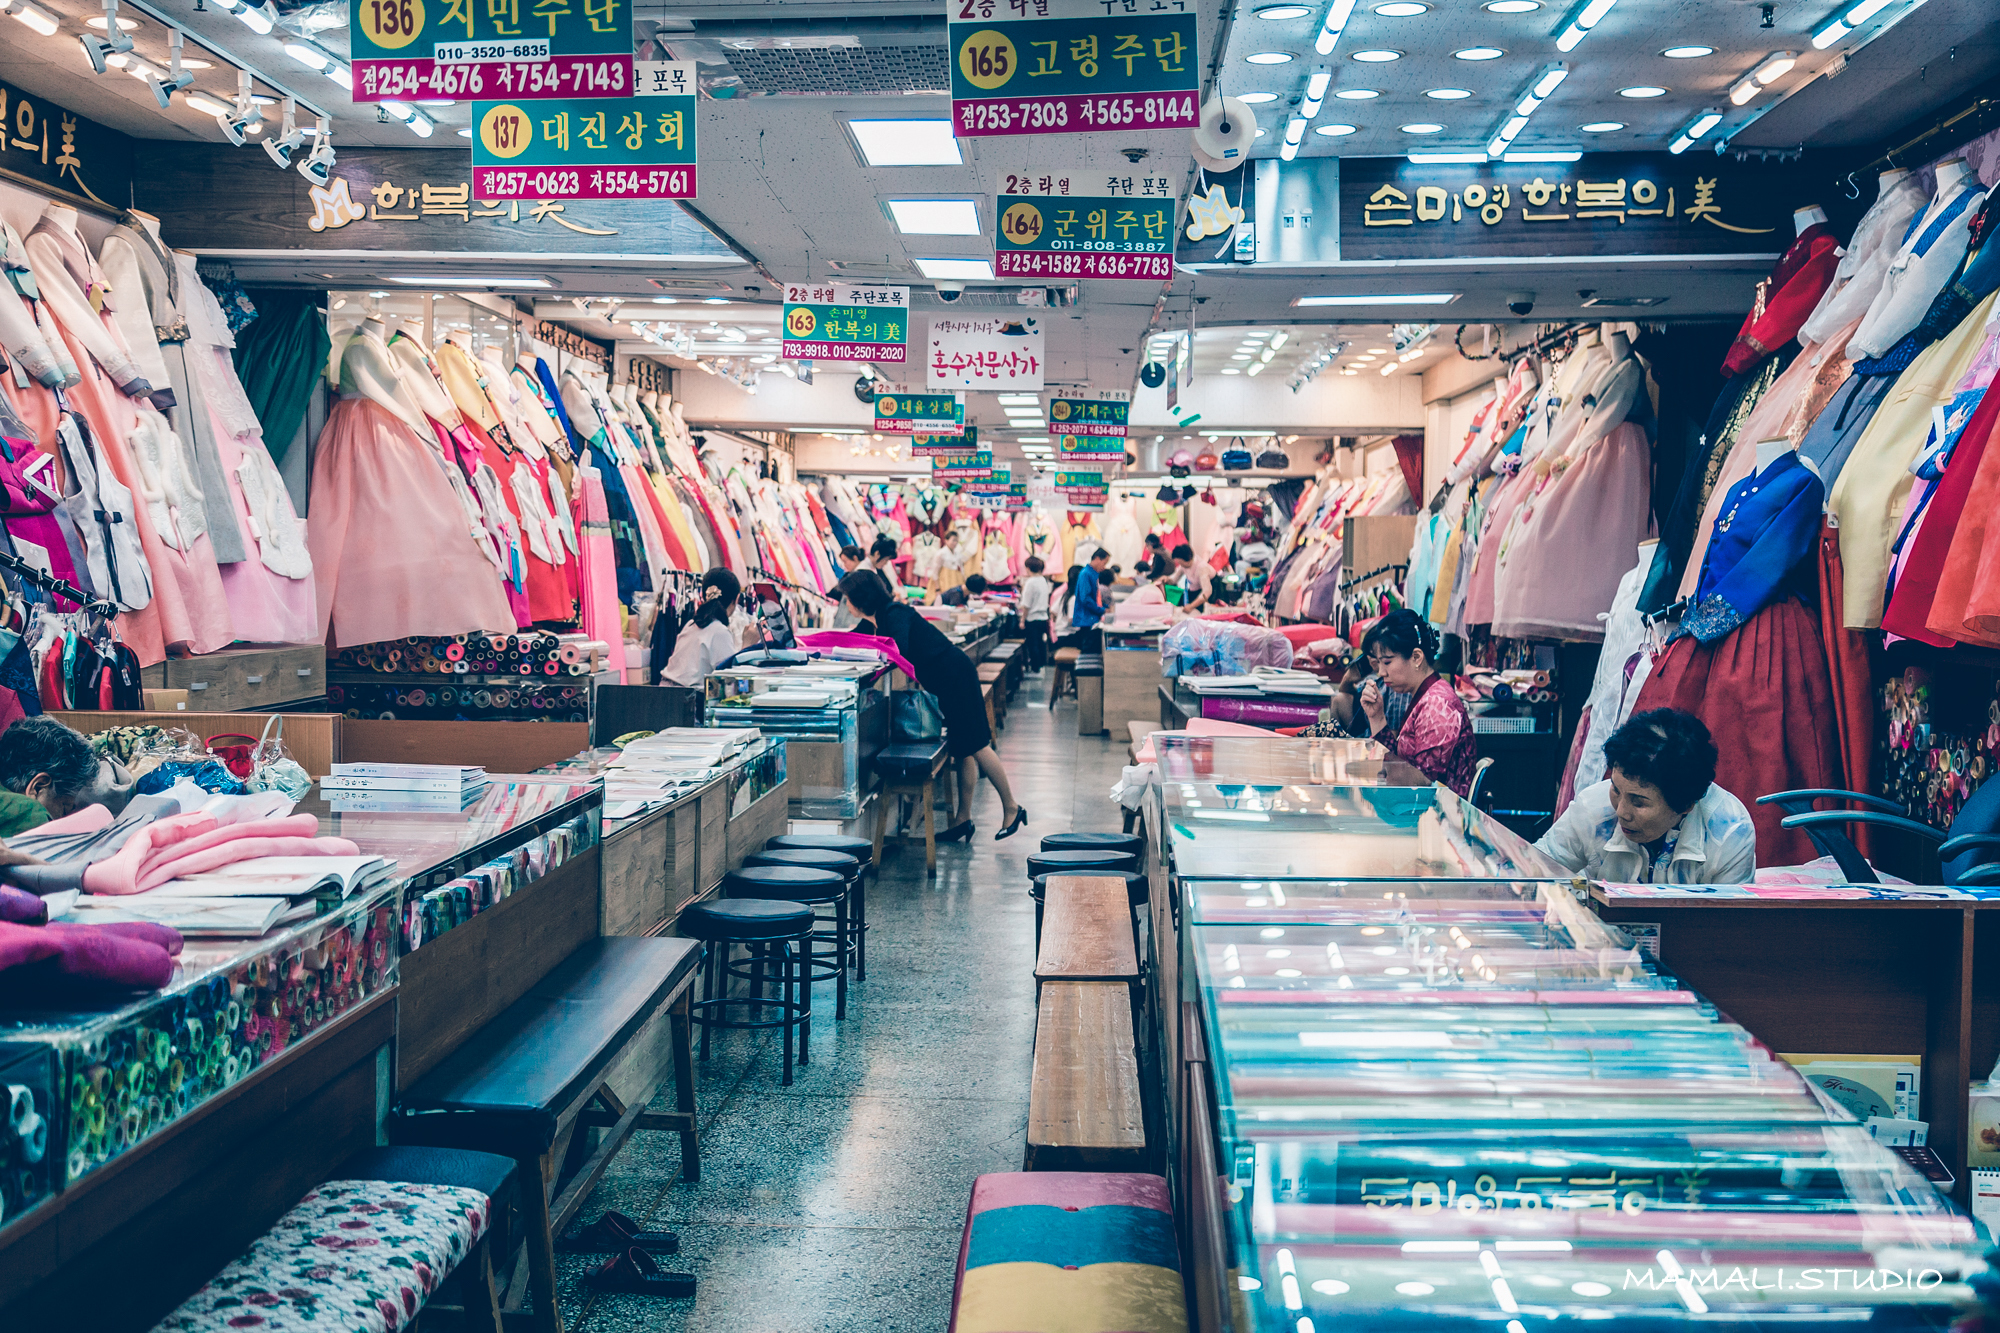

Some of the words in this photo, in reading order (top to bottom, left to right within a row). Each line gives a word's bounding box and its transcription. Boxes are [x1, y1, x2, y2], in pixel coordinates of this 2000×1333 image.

[371, 0, 415, 37] 136
[437, 44, 548, 60] 010-3520-6835
[968, 45, 1009, 77] 165
[1027, 32, 1188, 79] 고령주단
[0, 88, 48, 165] 의
[492, 115, 520, 149] 137
[540, 110, 685, 152] 대진상회
[1364, 183, 1510, 226] 손미영
[1522, 177, 1675, 225] 한복의
[1685, 176, 1776, 234] 美
[1005, 212, 1040, 236] 164
[1053, 209, 1168, 240] 군위주단
[1051, 239, 1166, 252] 011-808-3887
[789, 287, 808, 302] 2층
[813, 288, 835, 303] 라열
[788, 314, 814, 331] 163
[824, 320, 877, 340] 한복의
[883, 322, 901, 341] 美
[829, 307, 867, 320] 손미영
[833, 345, 904, 360] 010-2501-2020
[931, 349, 1040, 379] 혼수전문상가
[882, 401, 894, 411] 140
